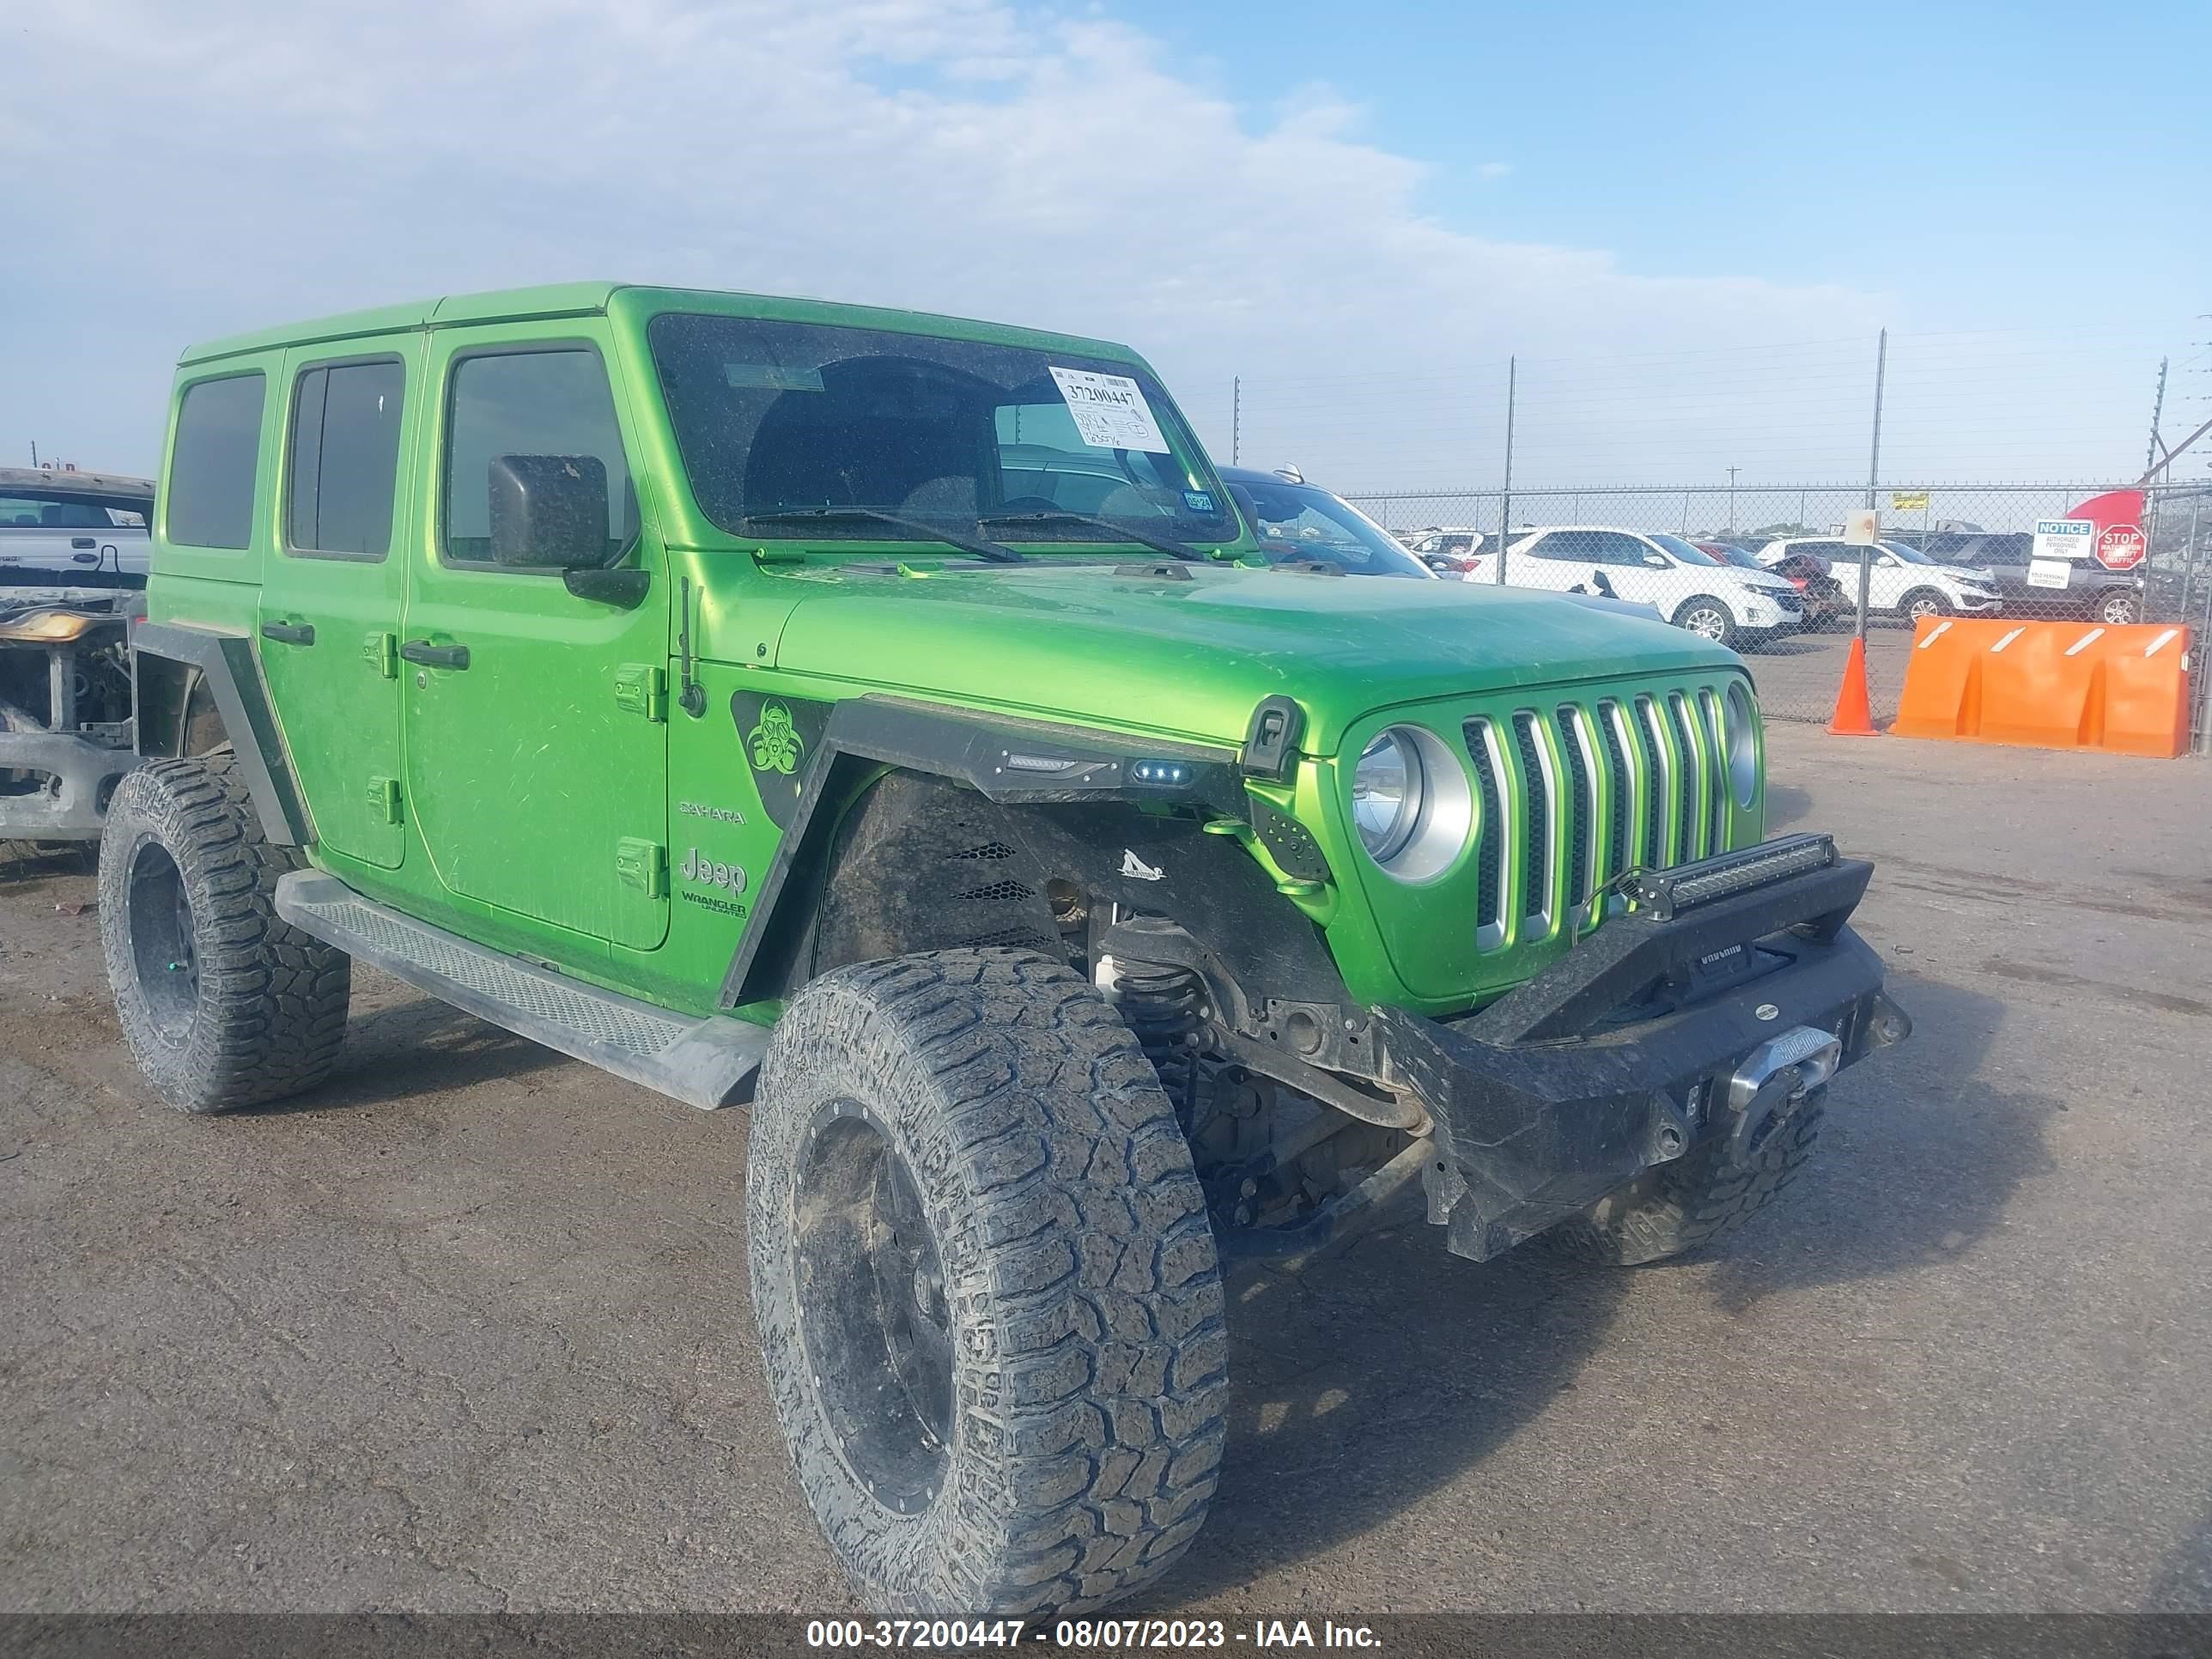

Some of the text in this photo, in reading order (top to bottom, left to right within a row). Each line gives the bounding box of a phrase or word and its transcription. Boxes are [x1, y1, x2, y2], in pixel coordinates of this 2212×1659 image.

[1067, 385, 1135, 406] 37200447
[2039, 523, 2088, 534] NOTICE
[2104, 533, 2140, 544] STOP
[680, 801, 747, 825] SAHARA
[680, 847, 748, 899] Jeep
[681, 890, 747, 914] WRANGLER
[701, 904, 747, 920] UNLIMITED
